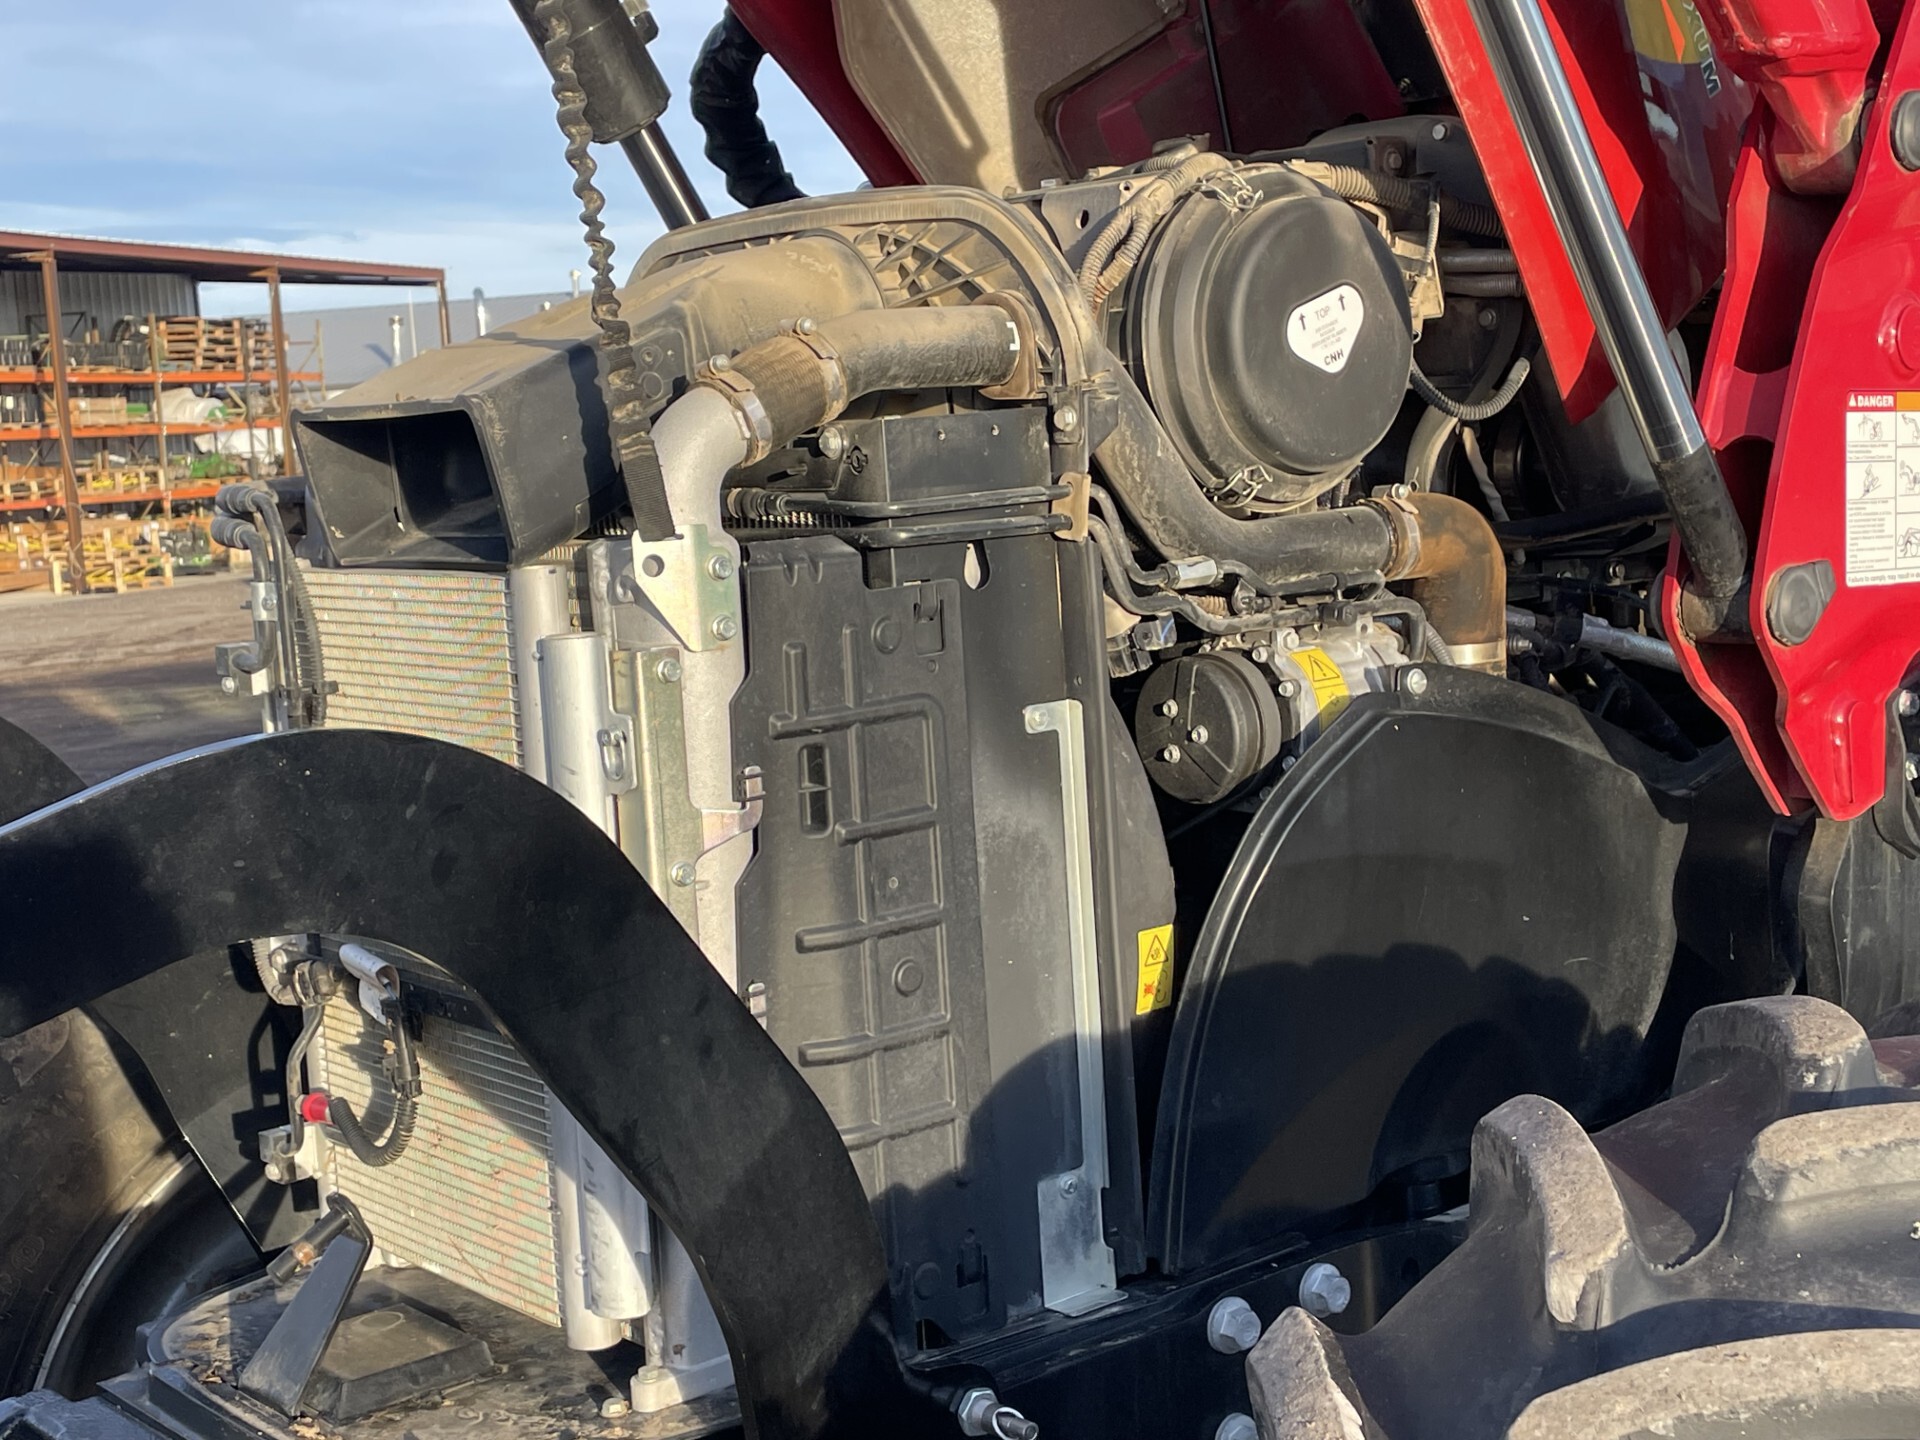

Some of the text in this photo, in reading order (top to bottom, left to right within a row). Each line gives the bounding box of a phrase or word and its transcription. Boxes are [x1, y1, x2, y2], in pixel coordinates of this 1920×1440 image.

[1314, 305, 1330, 320] TOP
[1324, 348, 1344, 366] CNH
[1857, 395, 1894, 407] DANGER
